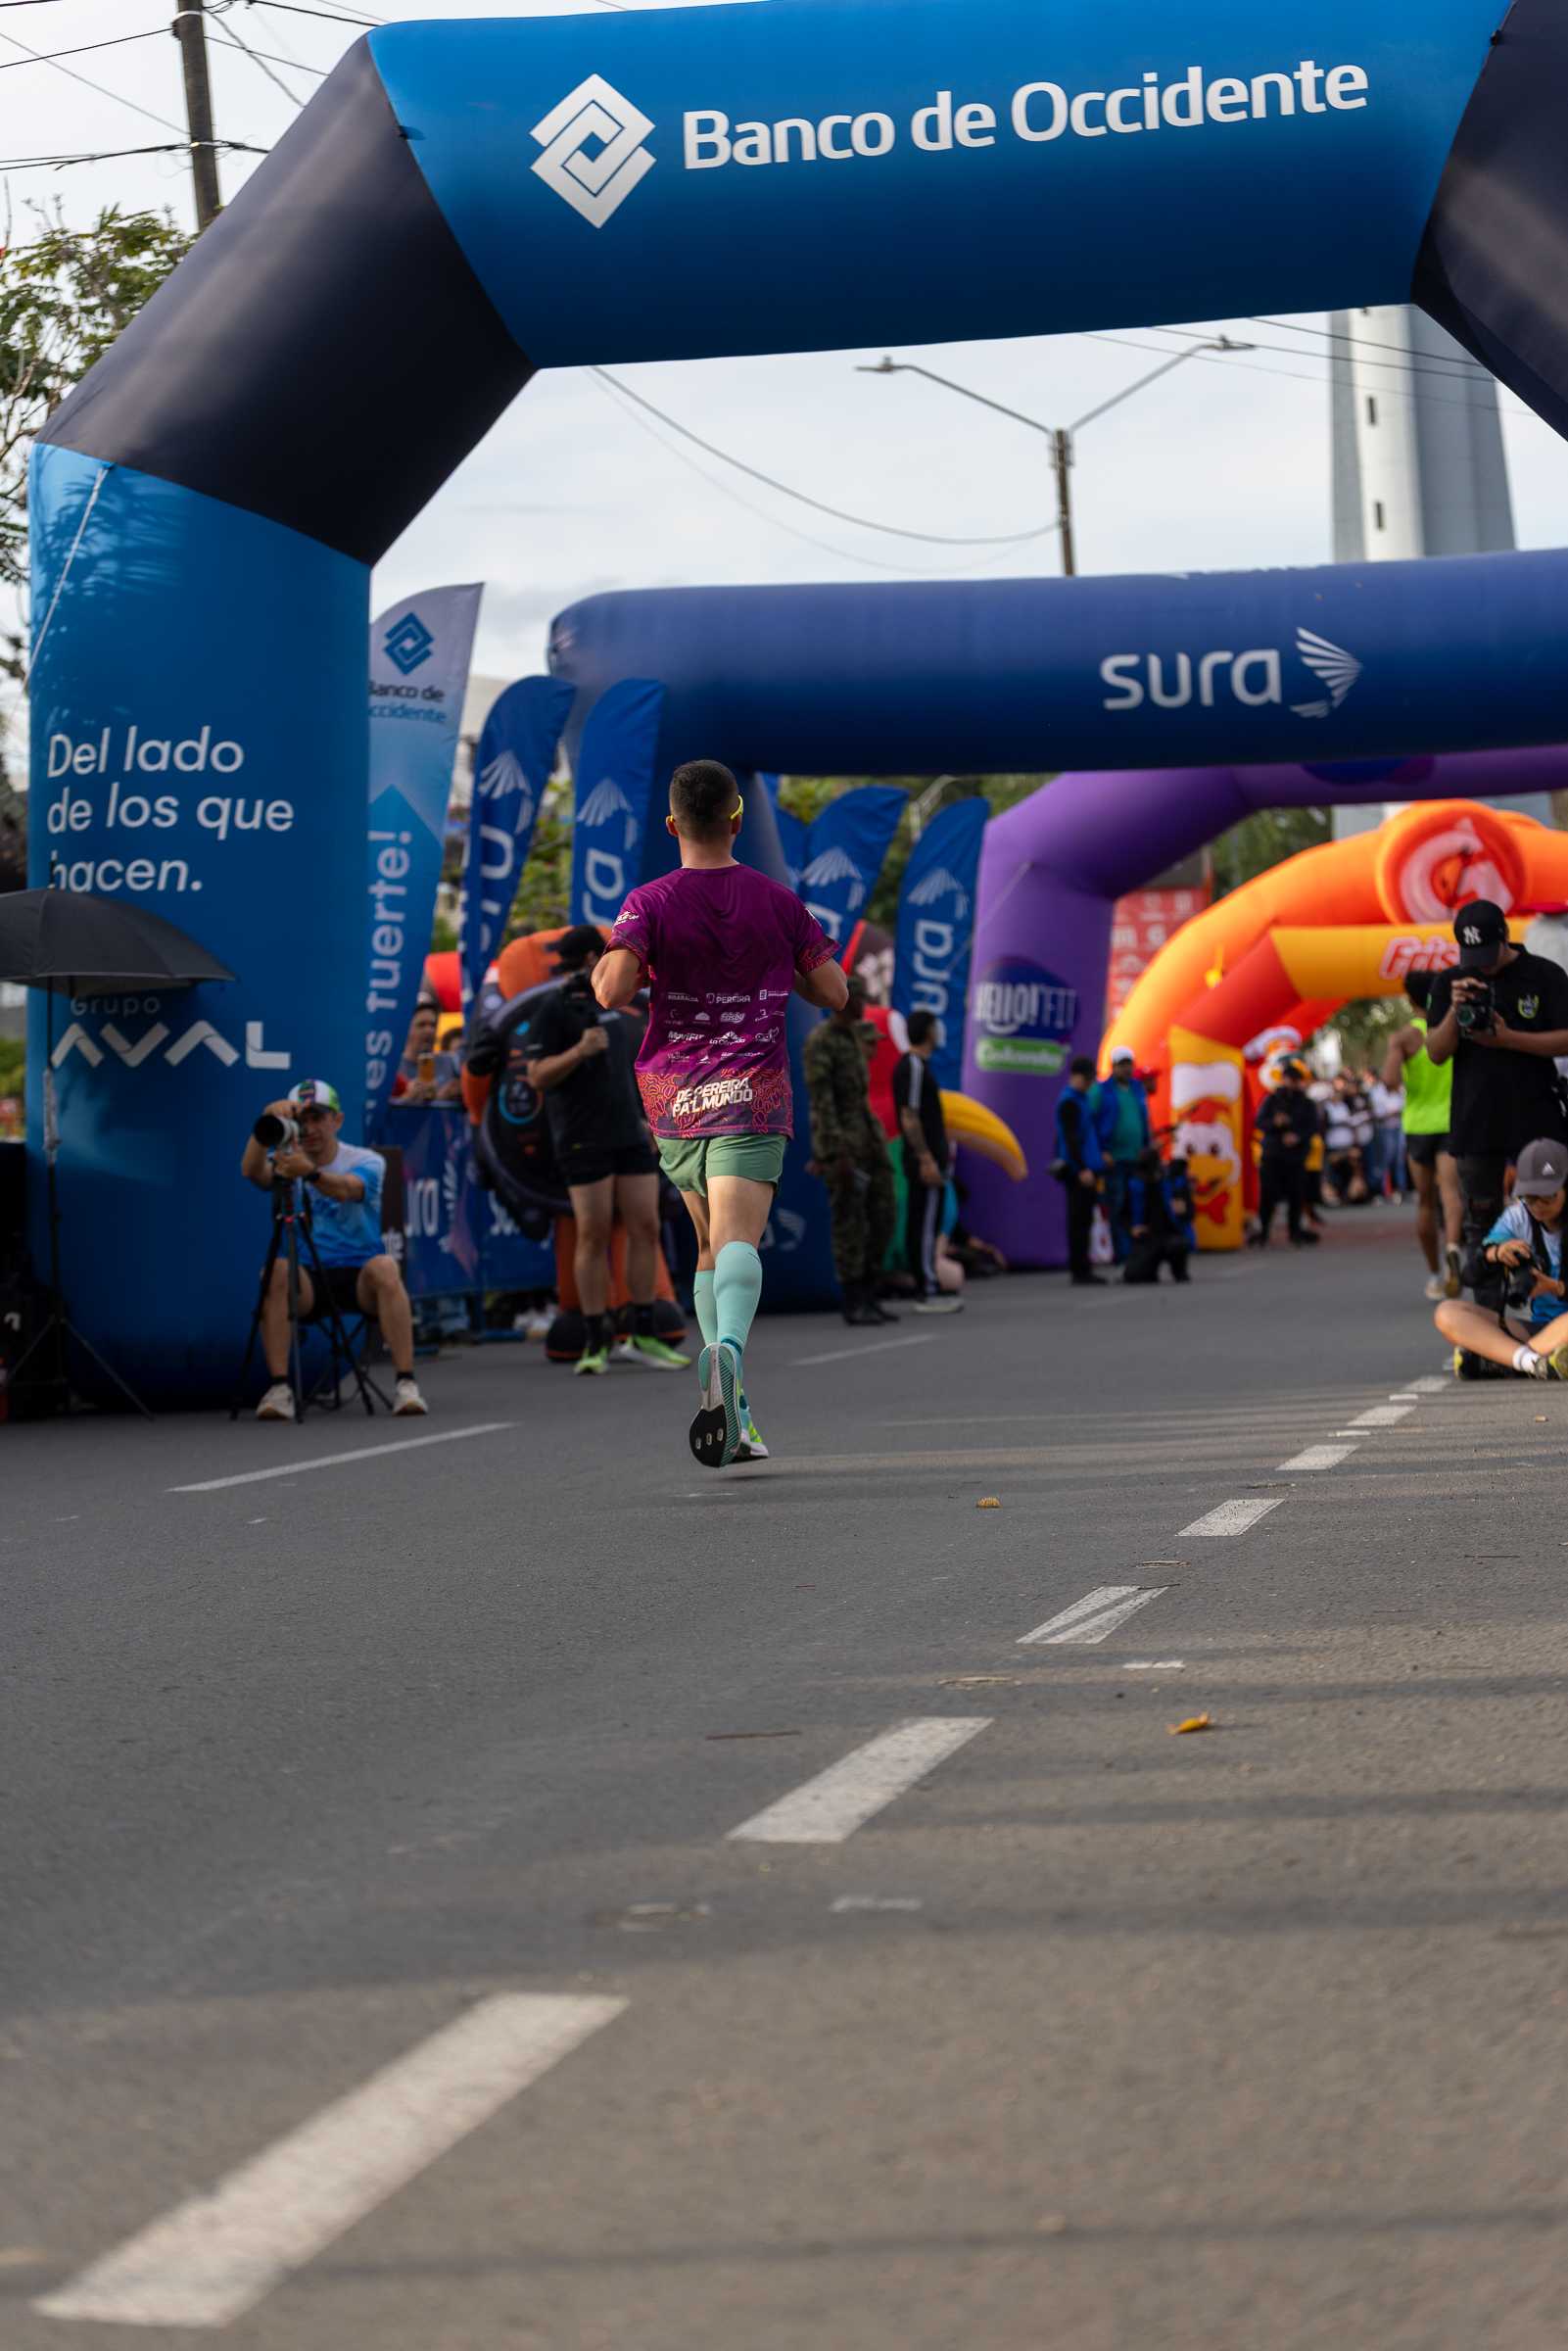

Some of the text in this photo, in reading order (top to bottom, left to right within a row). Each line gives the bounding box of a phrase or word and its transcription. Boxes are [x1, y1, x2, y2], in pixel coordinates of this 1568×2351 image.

[683, 59, 1370, 170] Banco de Occidente
[1099, 648, 1282, 711] sura
[47, 725, 246, 779] Del lado
[47, 782, 296, 841] de los que
[47, 848, 204, 894] hacen.
[1379, 935, 1460, 981] Fris
[70, 995, 162, 1018] Grupo
[50, 1019, 292, 1071] AVAL
[692, 1077, 750, 1099] PEREIRA
[701, 1087, 754, 1112] MUNDO
